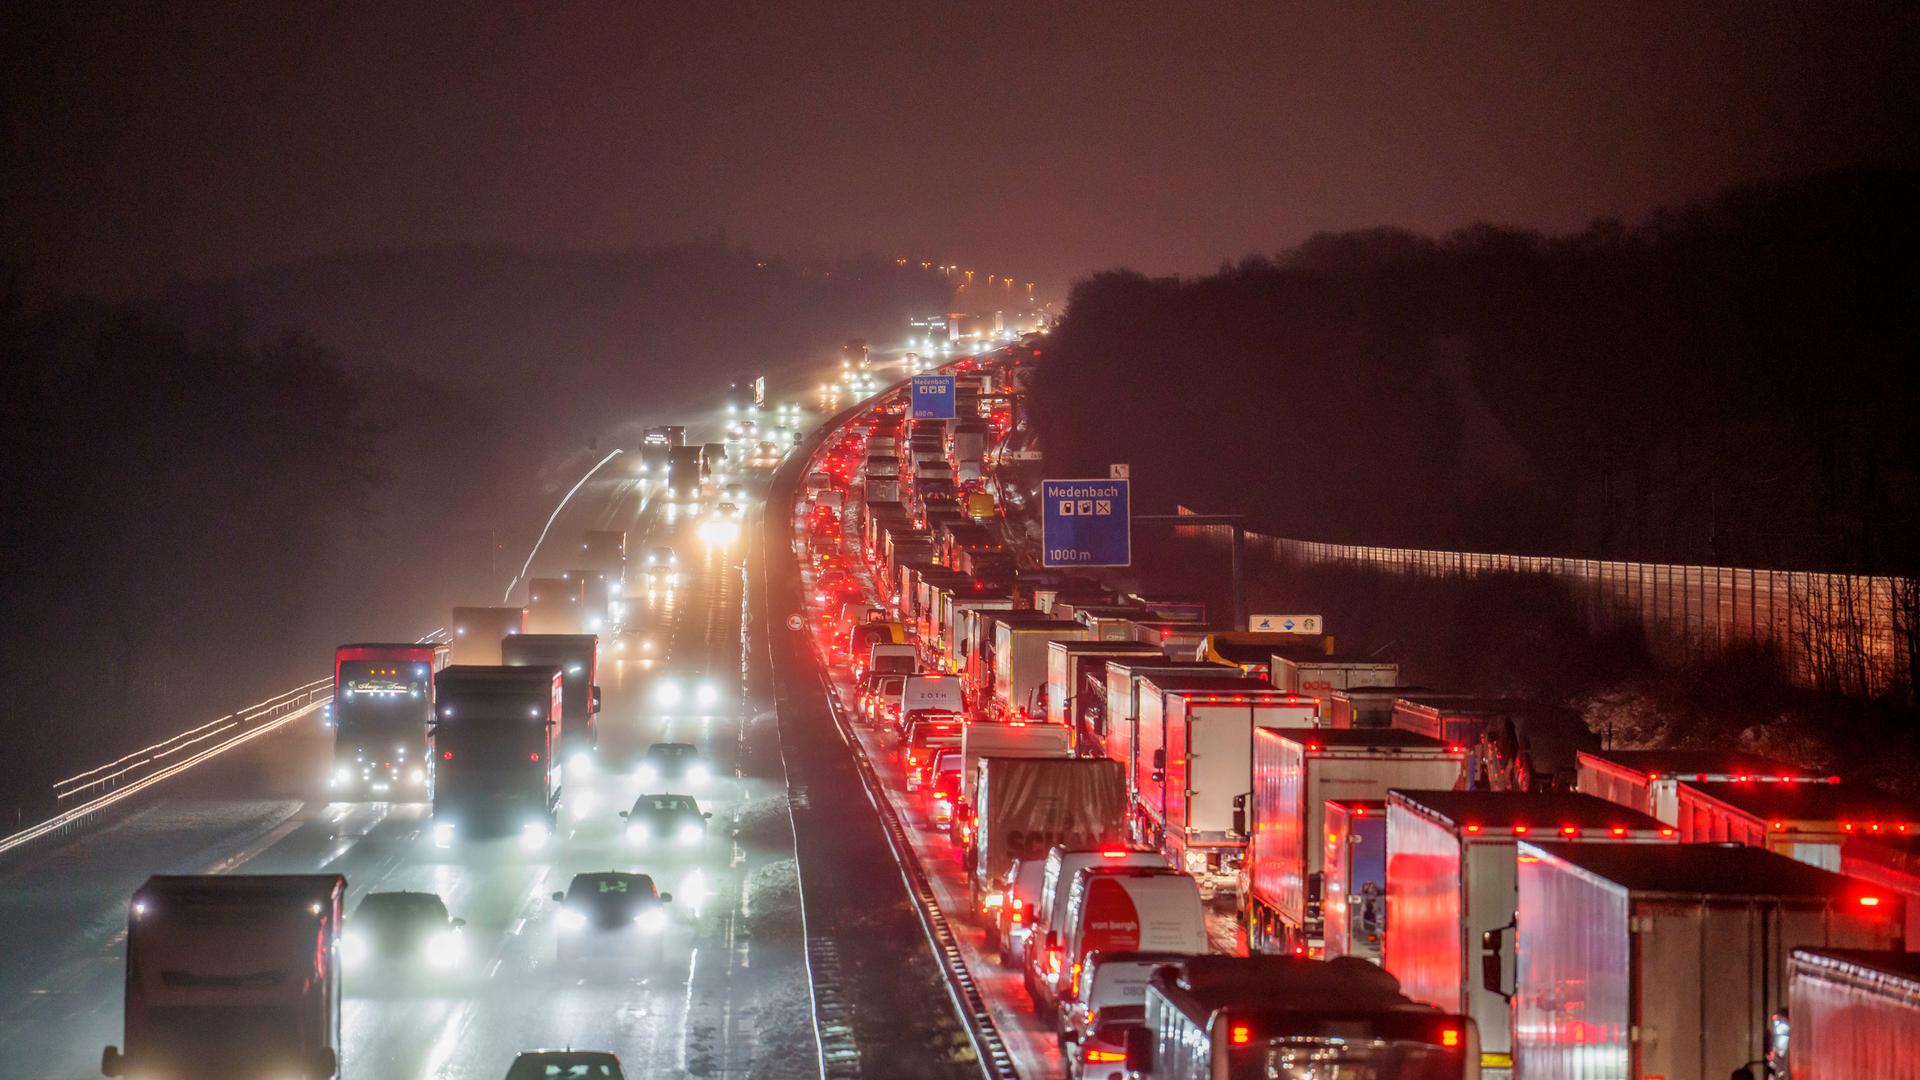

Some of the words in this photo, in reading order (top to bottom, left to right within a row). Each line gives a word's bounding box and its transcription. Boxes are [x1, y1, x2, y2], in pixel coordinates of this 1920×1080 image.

[1048, 486, 1118, 497] Medenbach
[1050, 549, 1077, 560] 1000
[1080, 551, 1091, 560] m
